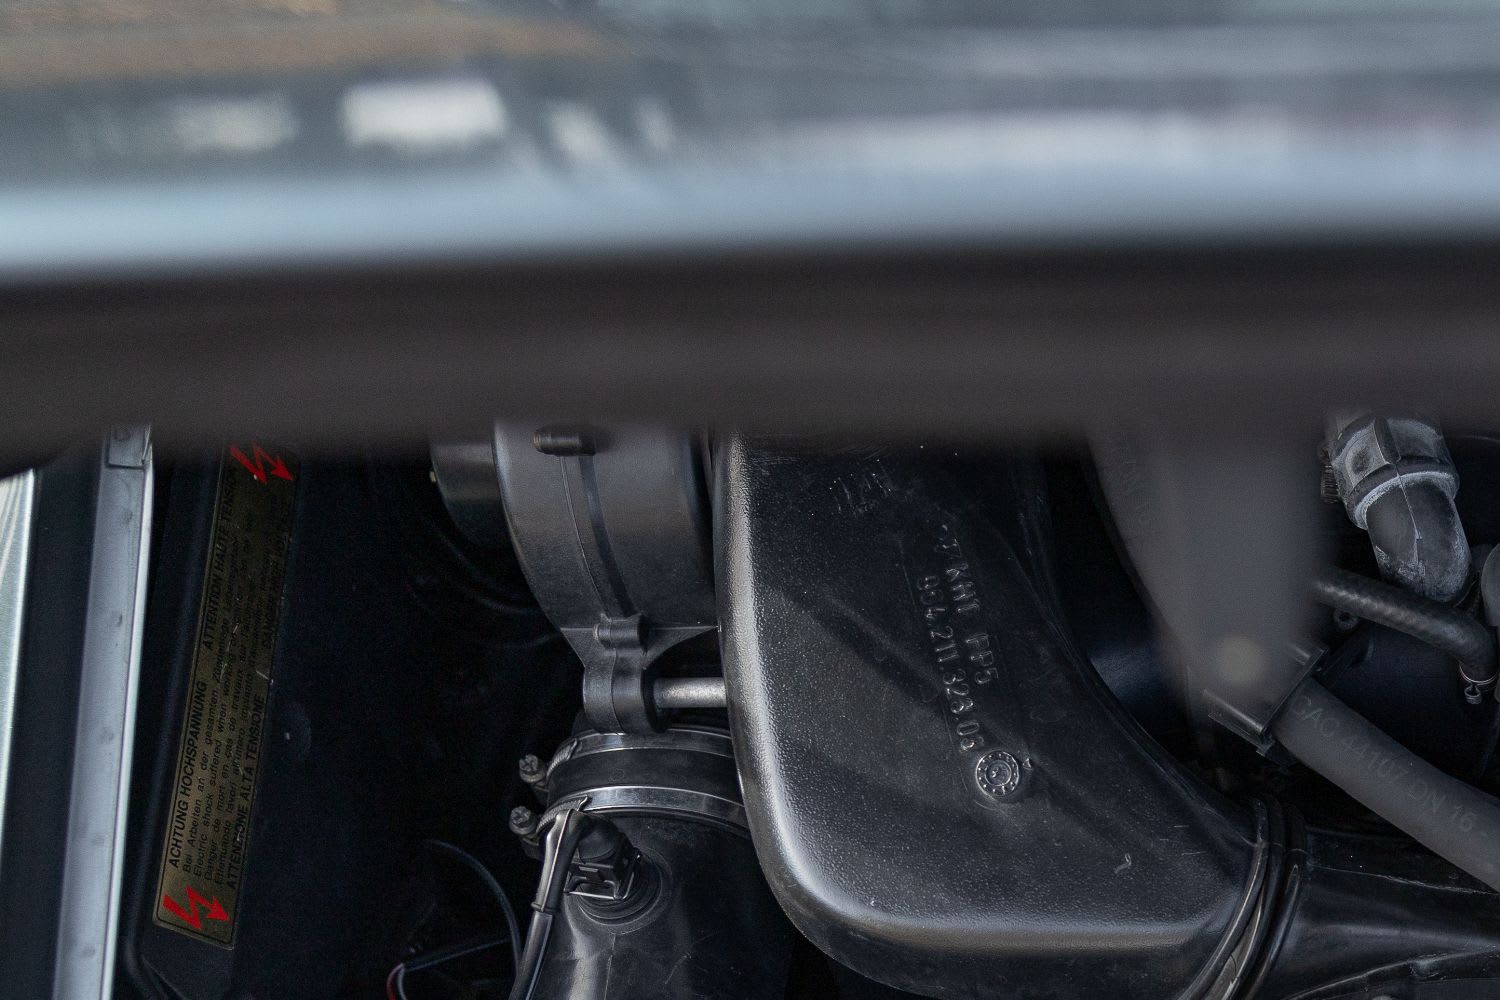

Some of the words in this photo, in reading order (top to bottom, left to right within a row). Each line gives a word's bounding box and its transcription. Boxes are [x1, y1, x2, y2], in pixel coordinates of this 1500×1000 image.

[201, 573, 223, 650] ATTENTION
[178, 679, 207, 797] HOCHSPANNUNG
[203, 689, 220, 745] gesamten
[244, 692, 265, 761] TENSIONE
[198, 750, 209, 771] der
[207, 738, 222, 787] suffered
[238, 764, 254, 802] ALTA
[186, 797, 202, 847] Arbeiten
[200, 791, 214, 827] shock
[203, 837, 219, 881] Danger
[215, 784, 226, 811] mort
[223, 737, 233, 758] cas
[1407, 778, 1444, 813] DN
[1446, 803, 1478, 833] 16
[168, 798, 189, 869] ACHTUNG
[193, 832, 208, 877] Electric
[224, 802, 248, 890] ATTENZIONE
[182, 852, 193, 873] Bei
